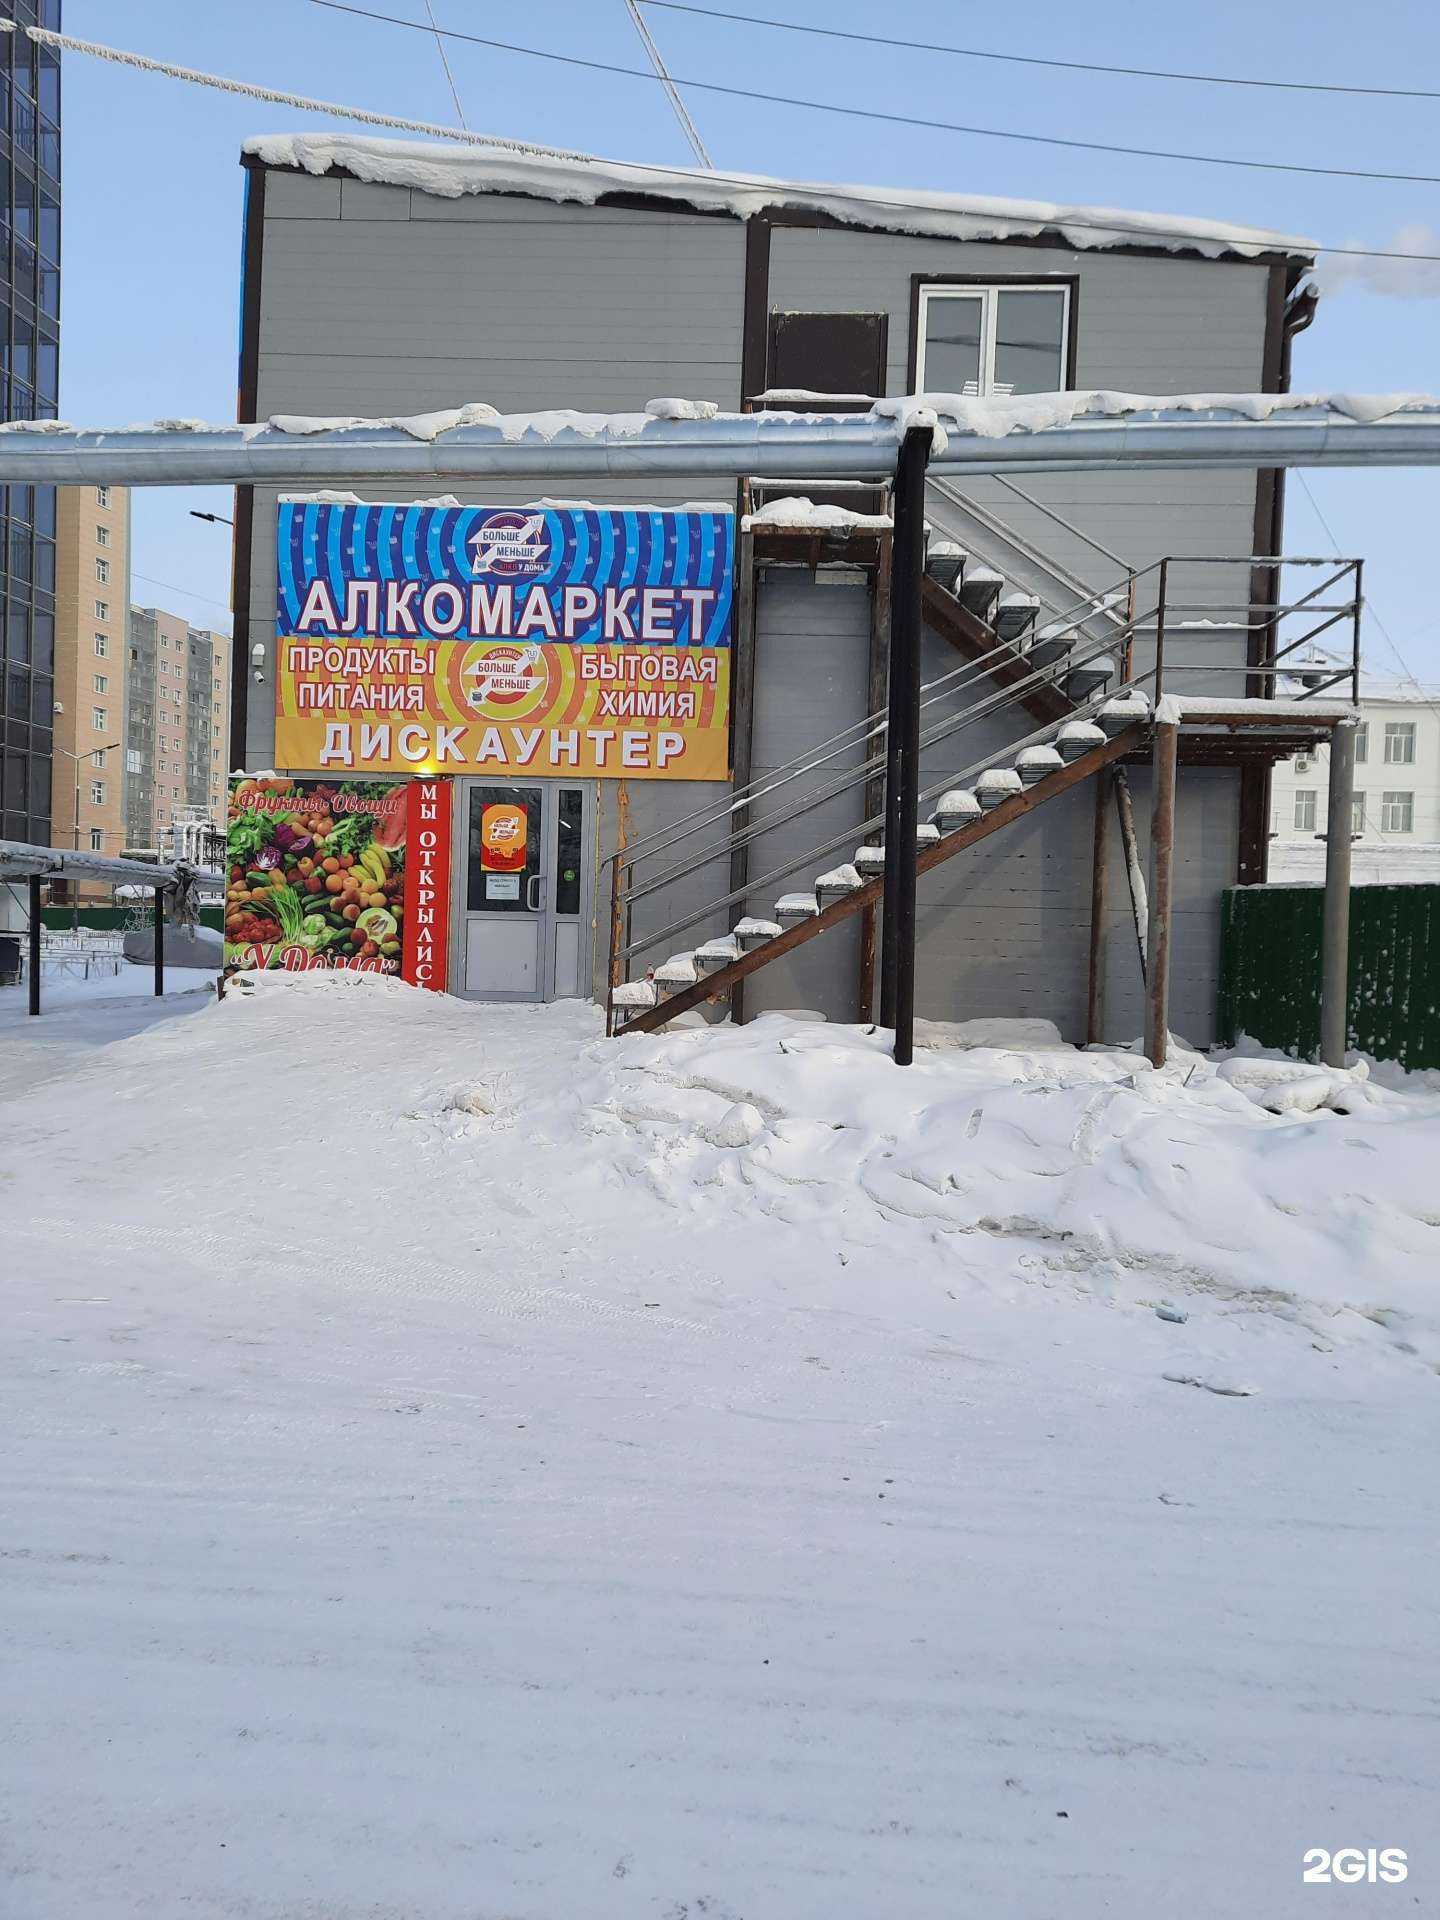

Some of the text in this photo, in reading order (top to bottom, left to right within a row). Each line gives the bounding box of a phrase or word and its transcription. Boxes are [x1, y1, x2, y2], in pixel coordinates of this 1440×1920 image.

[482, 530, 520, 541] БОЛЬШЕ
[496, 546, 535, 557] МЕНЬШЕ
[524, 564, 544, 572] ДОМА
[298, 580, 714, 640] АЛКОМАРКЕТ
[289, 646, 435, 676] ПРОДУКТЫ
[478, 662, 517, 673] БОЛЬШЕ
[580, 654, 718, 682] БЫТОВАЯ
[299, 683, 424, 711] ПИТАНИЯ
[491, 678, 531, 689] МЕНЬШЕ
[599, 690, 695, 719] ХИМИЯ
[320, 723, 686, 768] ДИСКАУНТЕР
[239, 790, 399, 818] Фрукты Овощи
[420, 785, 437, 820] МЫ
